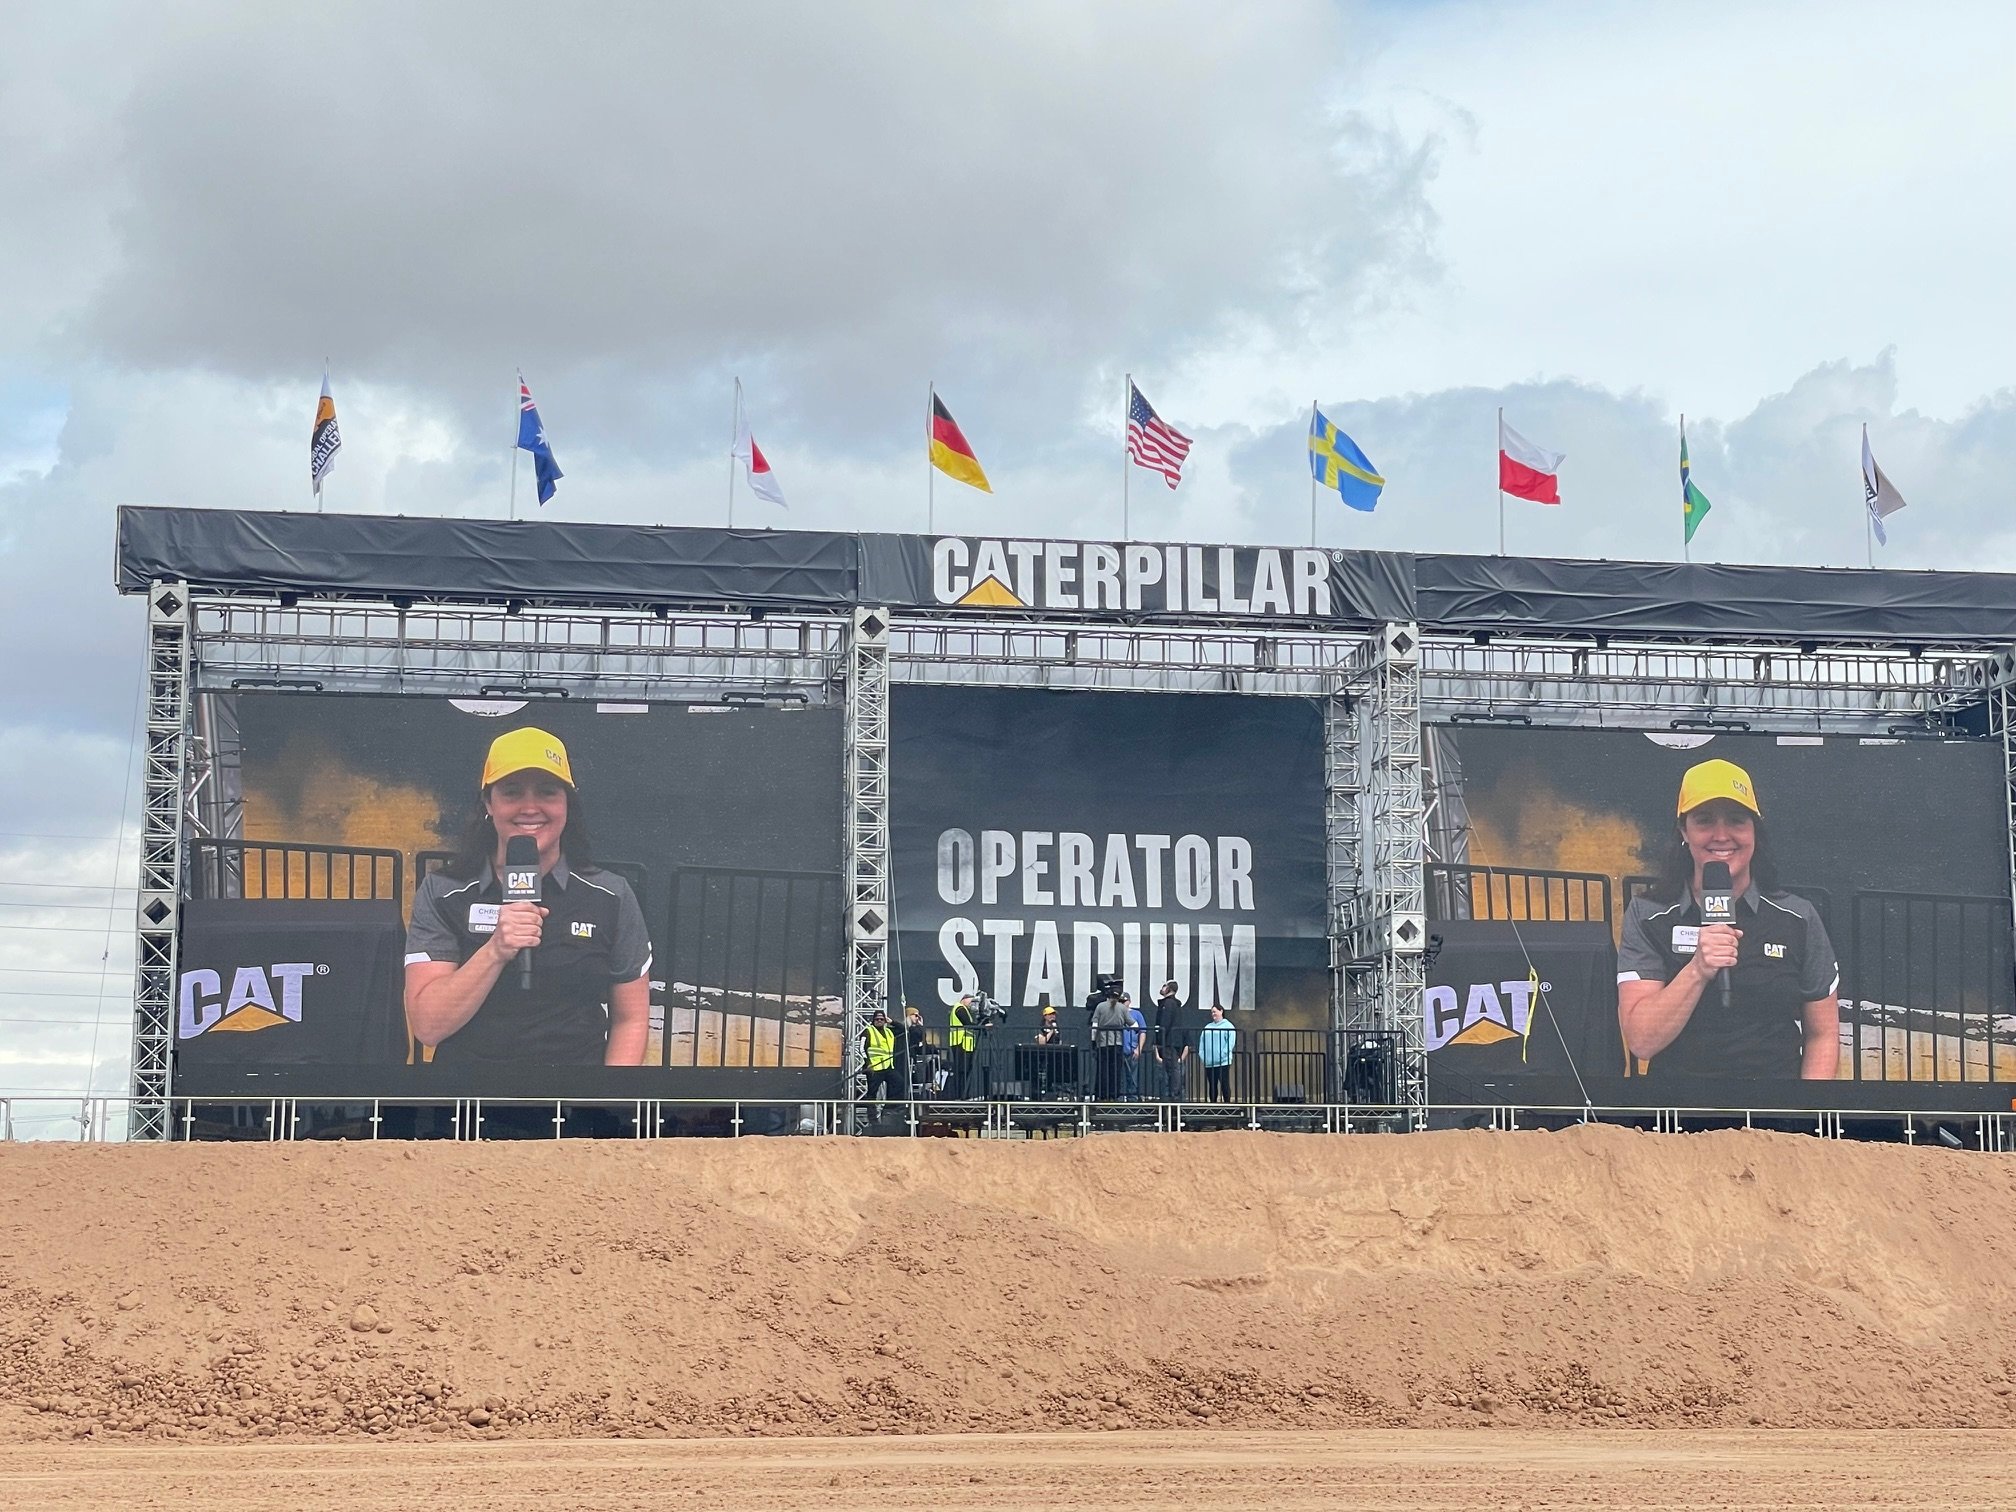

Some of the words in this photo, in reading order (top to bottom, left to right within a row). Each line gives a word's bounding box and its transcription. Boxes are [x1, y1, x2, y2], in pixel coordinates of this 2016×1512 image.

[545, 749, 562, 767] CAT
[1733, 780, 1748, 797] CAT
[937, 828, 1255, 911] OPERATOR
[508, 872, 536, 889] CAT
[1704, 896, 1730, 912] CAT
[571, 921, 595, 938] CAT
[1763, 943, 1785, 958] CAT
[937, 917, 1256, 1011] STADIUM
